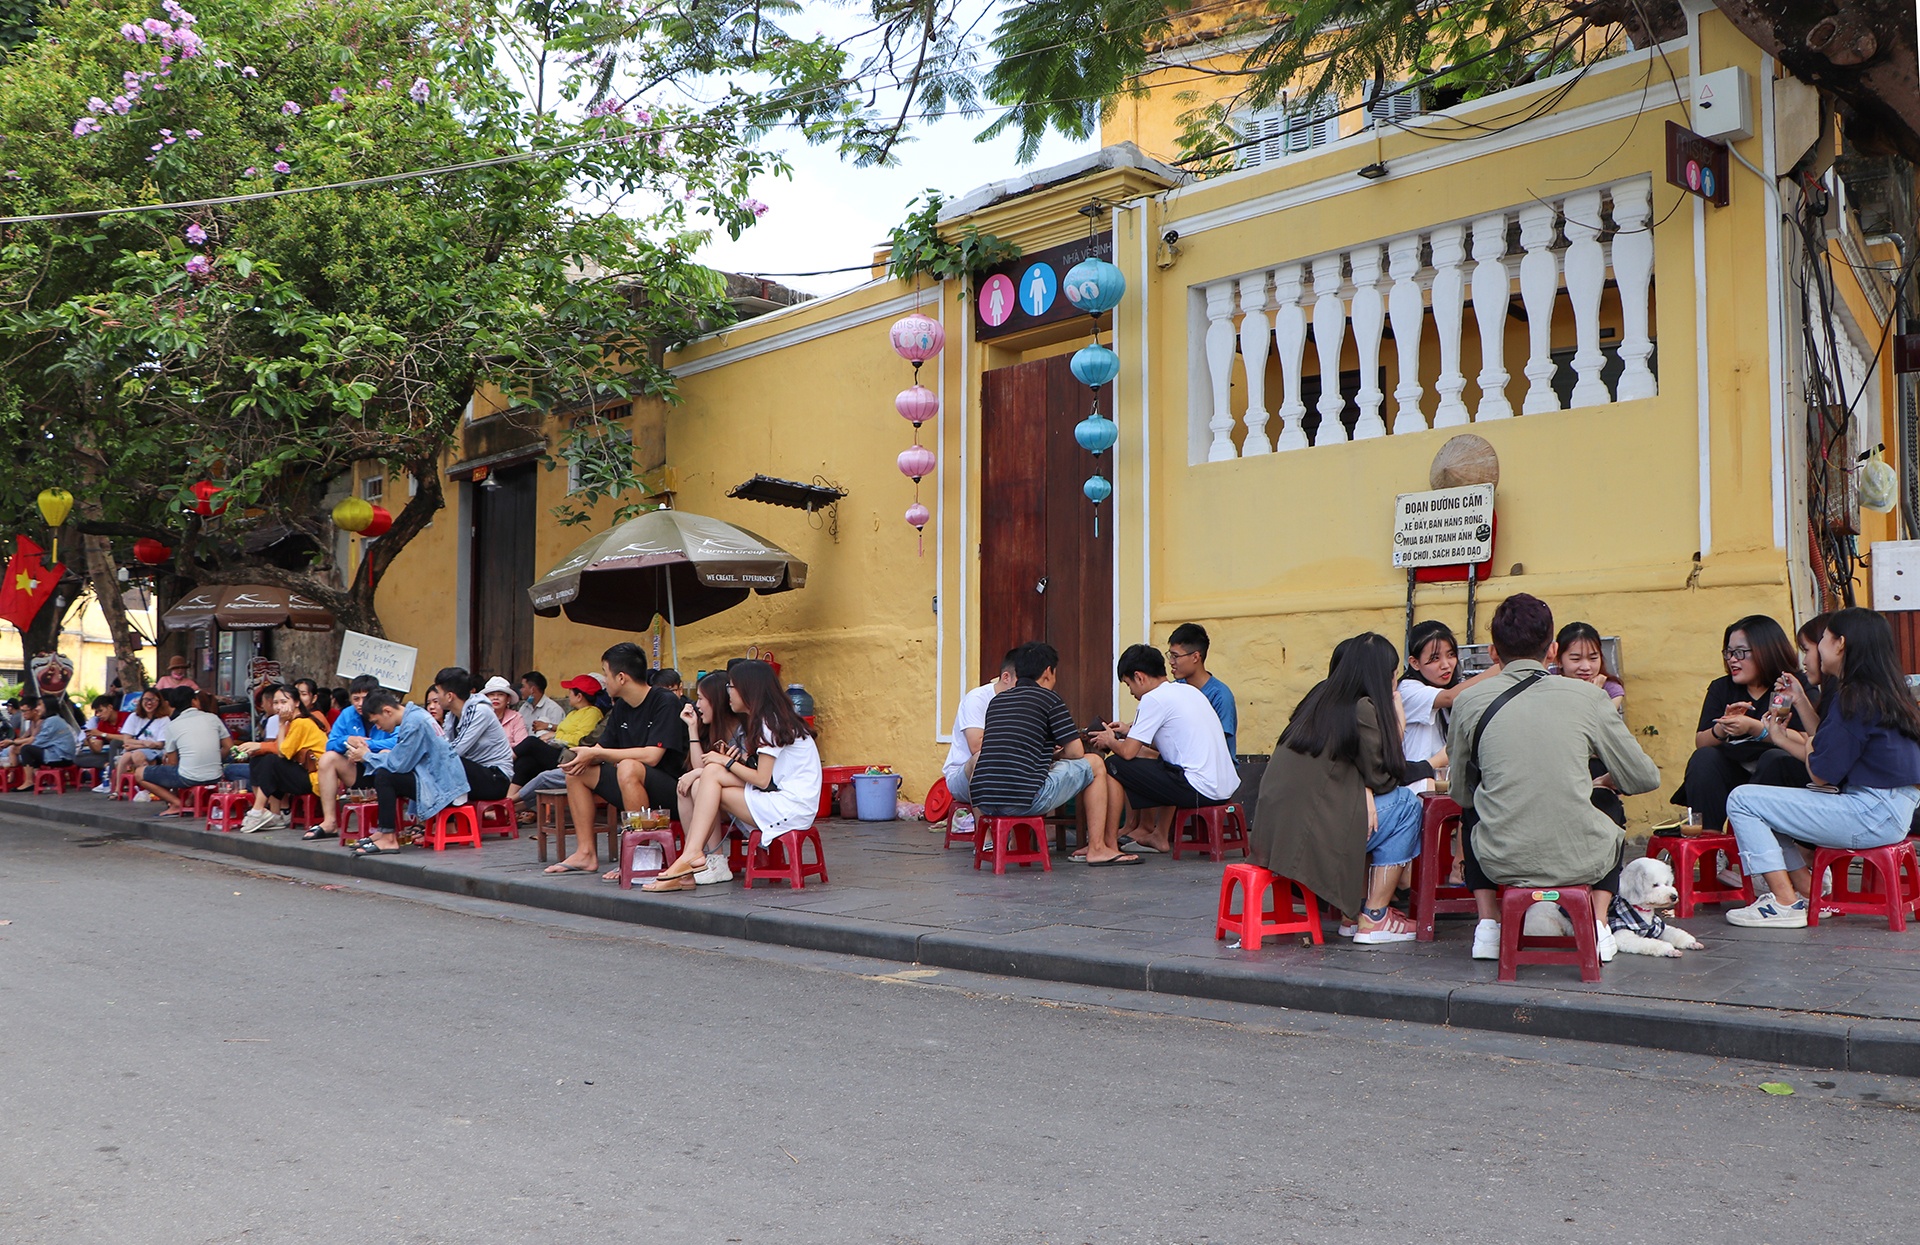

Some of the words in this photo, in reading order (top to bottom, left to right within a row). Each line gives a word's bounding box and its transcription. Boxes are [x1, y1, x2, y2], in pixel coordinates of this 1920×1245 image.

[1405, 501, 1428, 515] ĐOẠN
[1431, 496, 1460, 511] ĐƯỜNG
[1462, 493, 1482, 508] CẤM
[1435, 533, 1456, 543] TRANH
